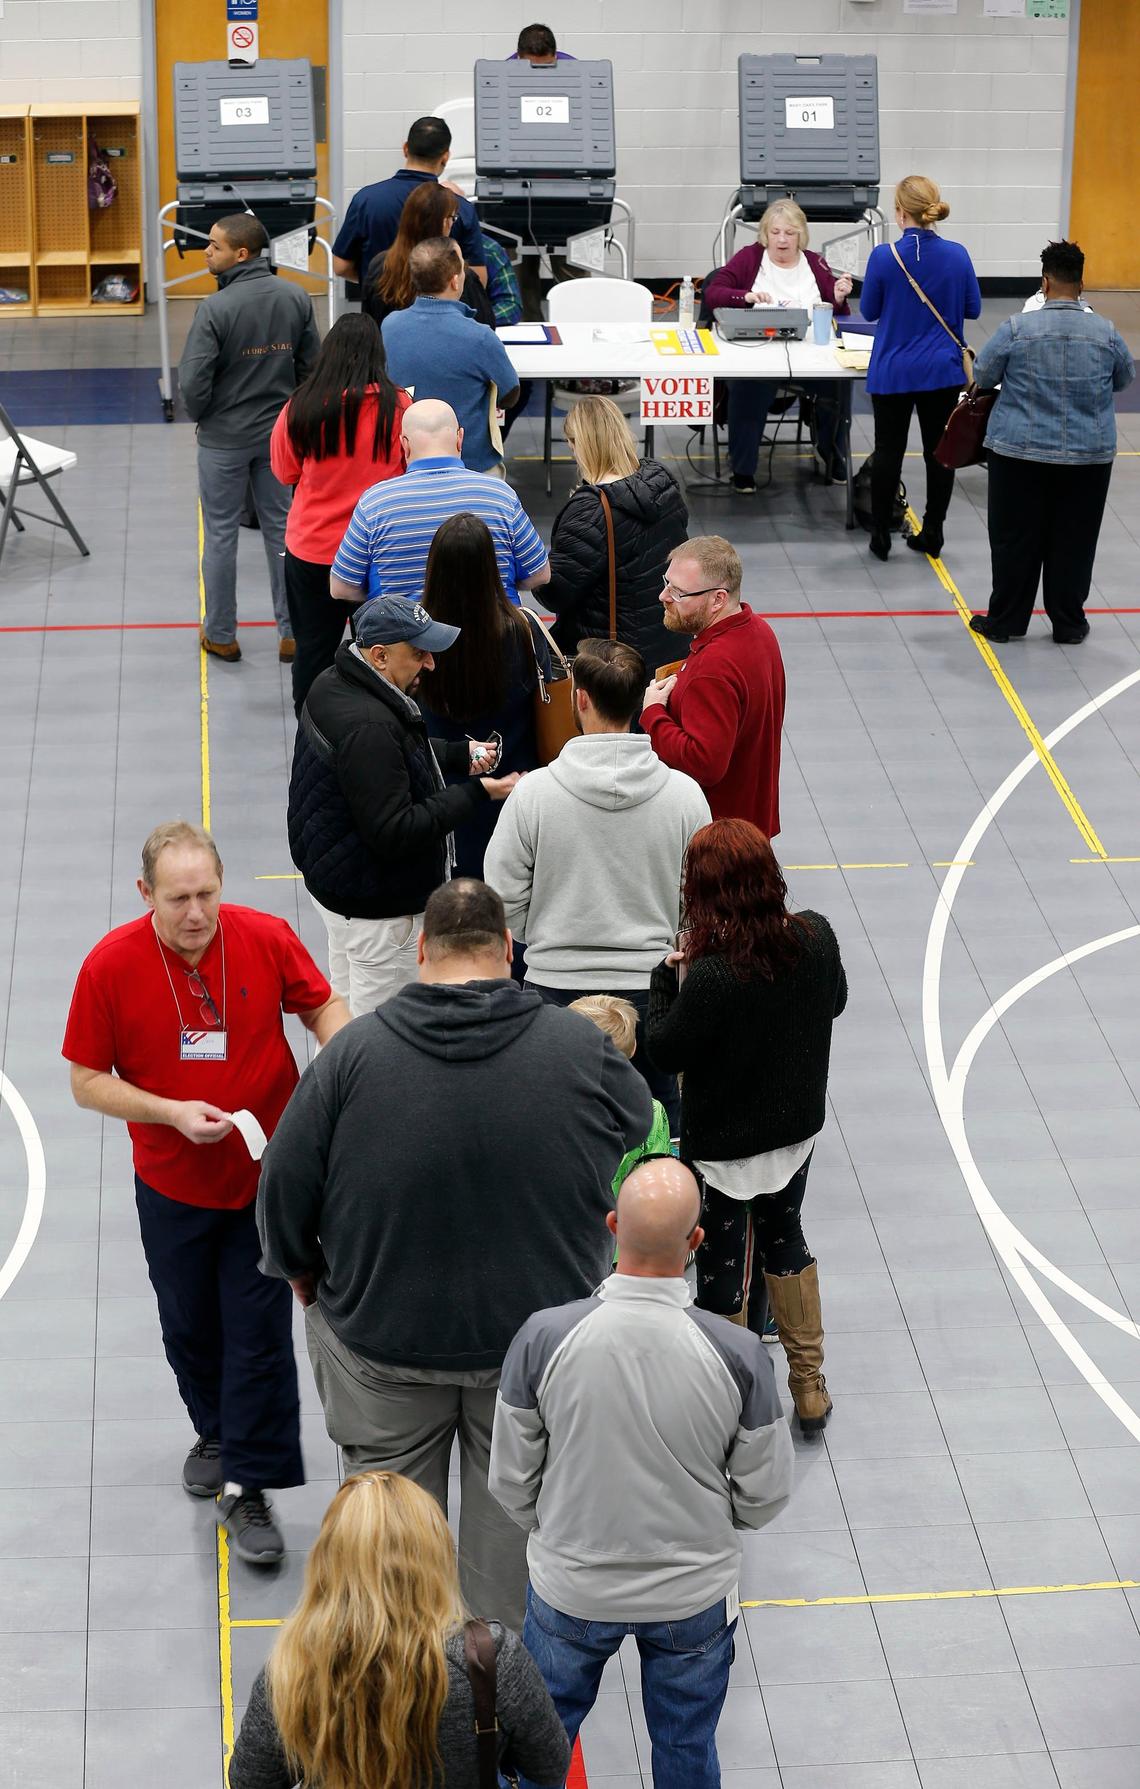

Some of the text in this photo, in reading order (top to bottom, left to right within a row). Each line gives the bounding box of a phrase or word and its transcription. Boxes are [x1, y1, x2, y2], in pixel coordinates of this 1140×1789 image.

[235, 107, 252, 118] 03
[536, 106, 552, 116] 02
[802, 110, 817, 122] 01
[643, 377, 710, 396] VOTE
[642, 400, 712, 418] HERE
